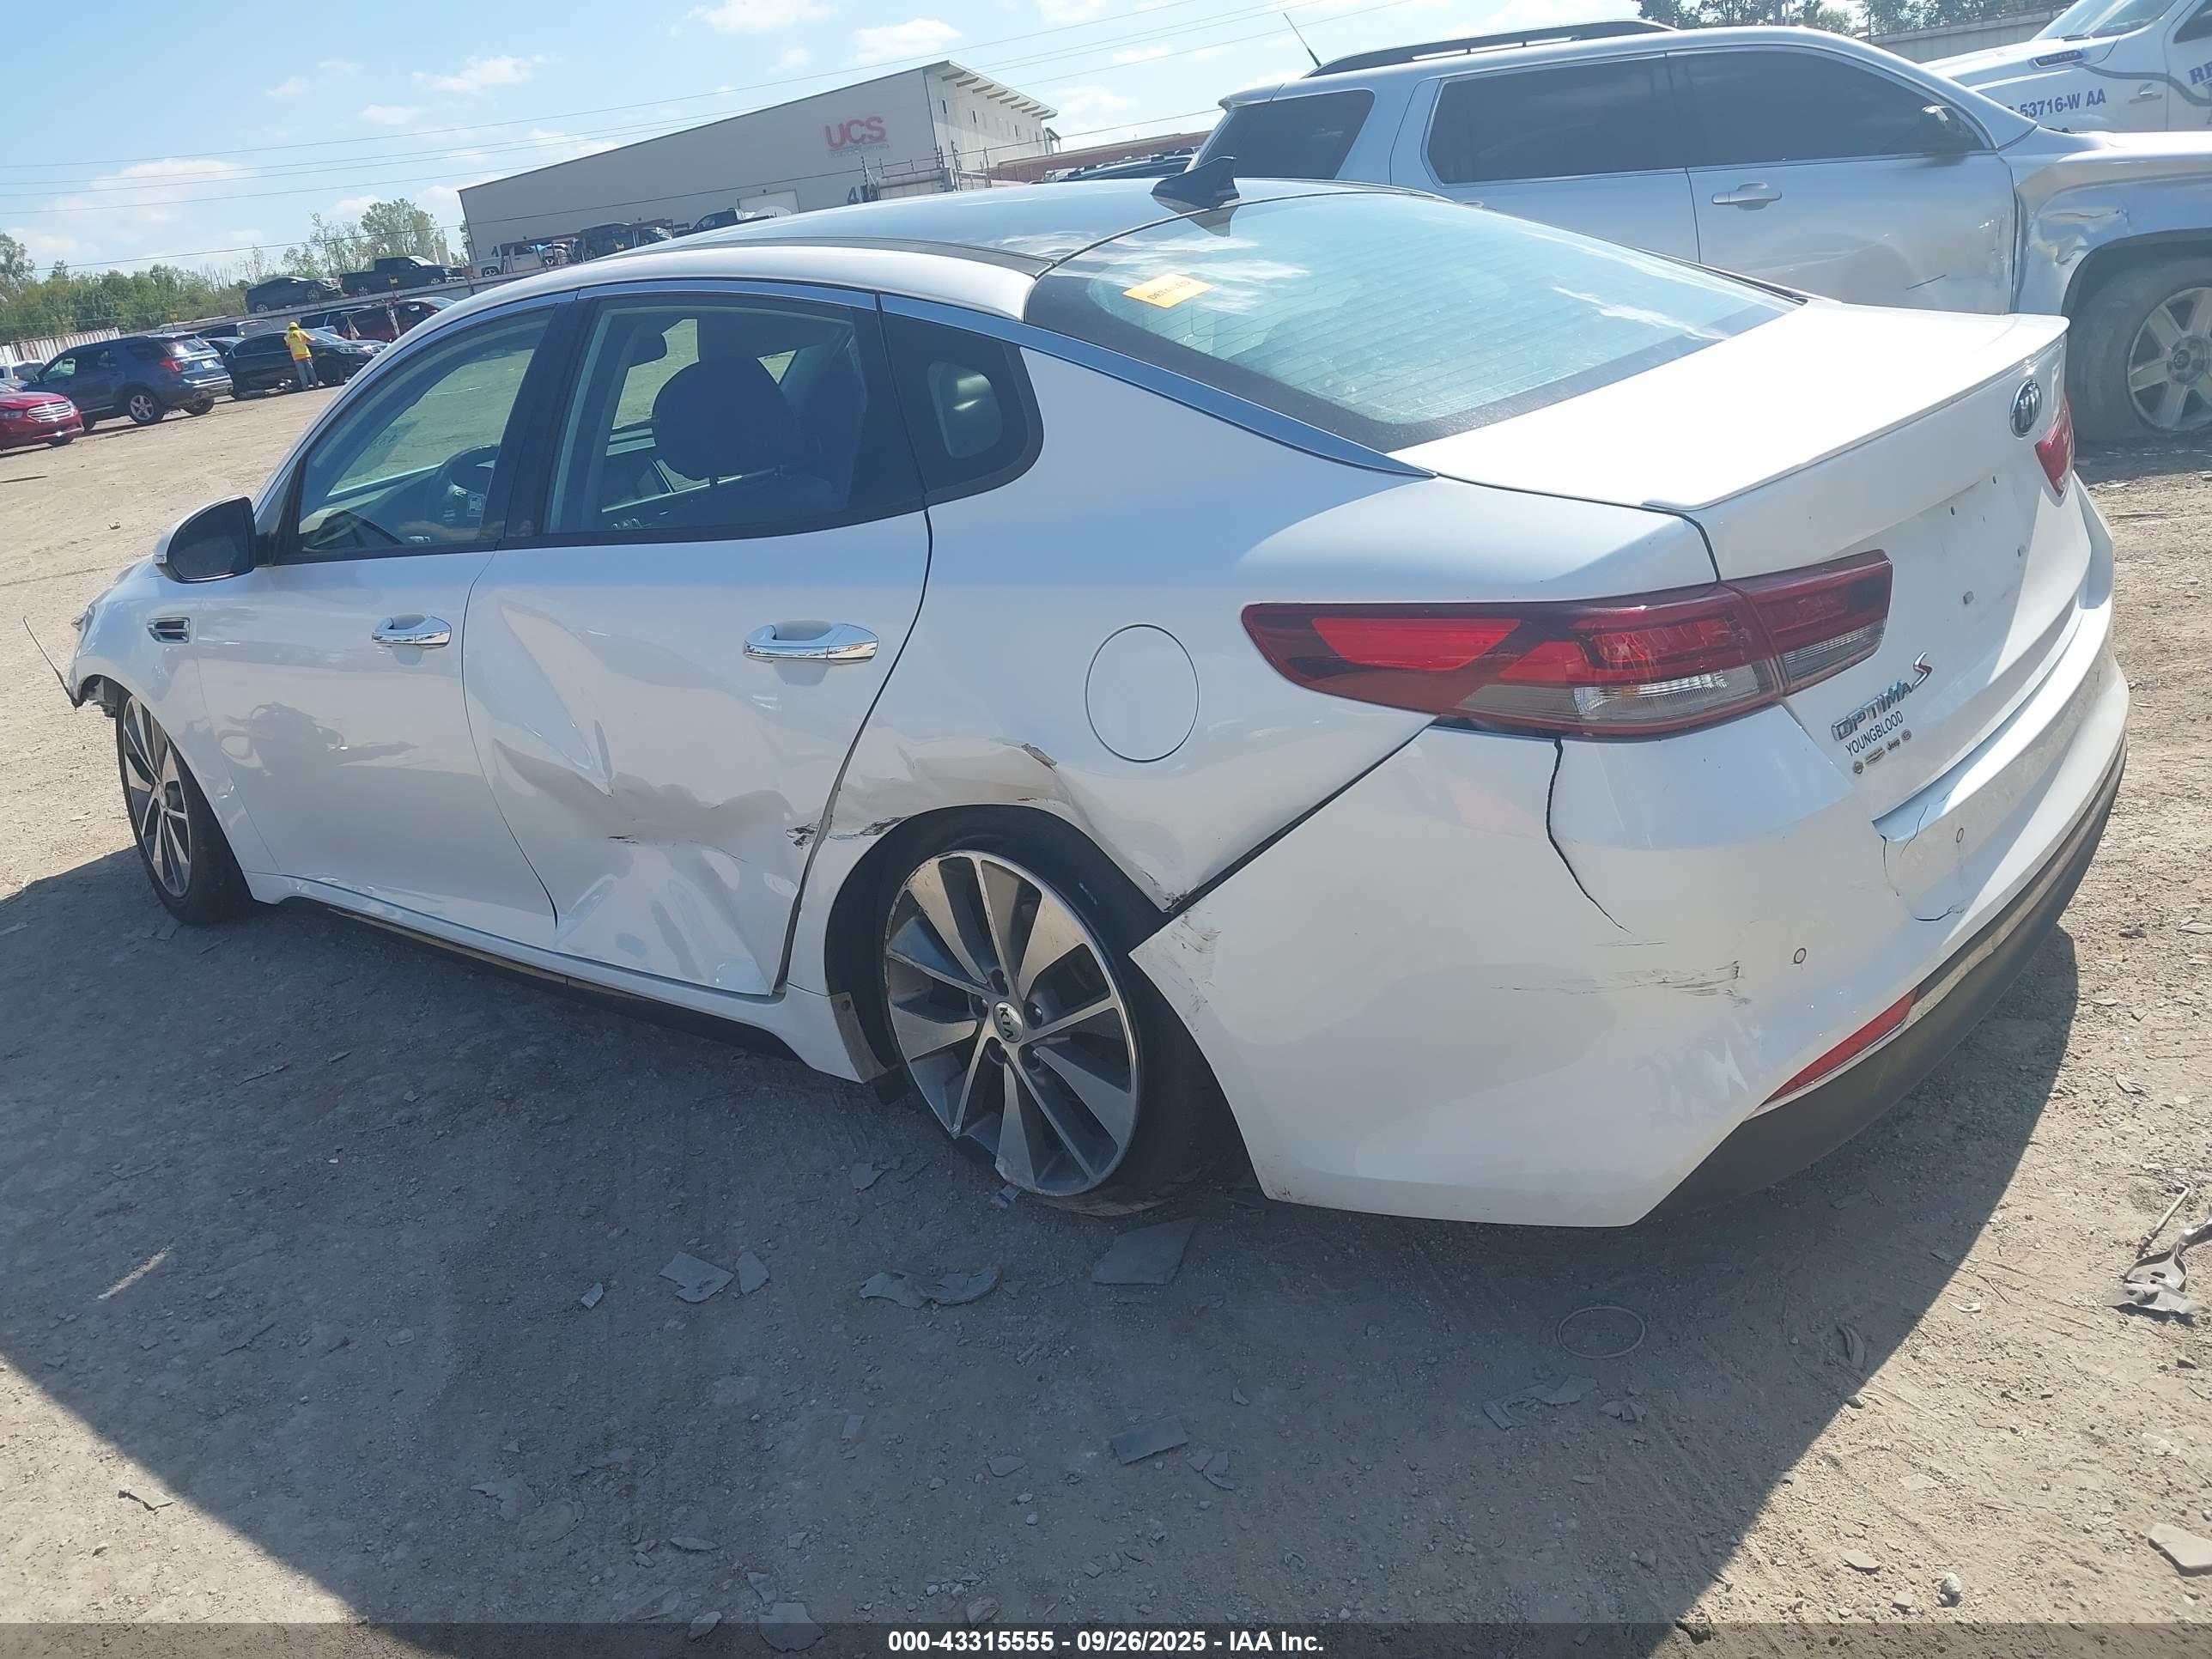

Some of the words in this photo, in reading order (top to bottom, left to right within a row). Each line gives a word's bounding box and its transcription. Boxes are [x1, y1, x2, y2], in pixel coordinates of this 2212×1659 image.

[2086, 88, 2106, 107] AA
[824, 116, 886, 148] UCS
[1831, 680, 1914, 741] OPTIMA
[1845, 710, 1904, 757] YOUNGBLOOD
[1887, 738, 1900, 750] Jeep
